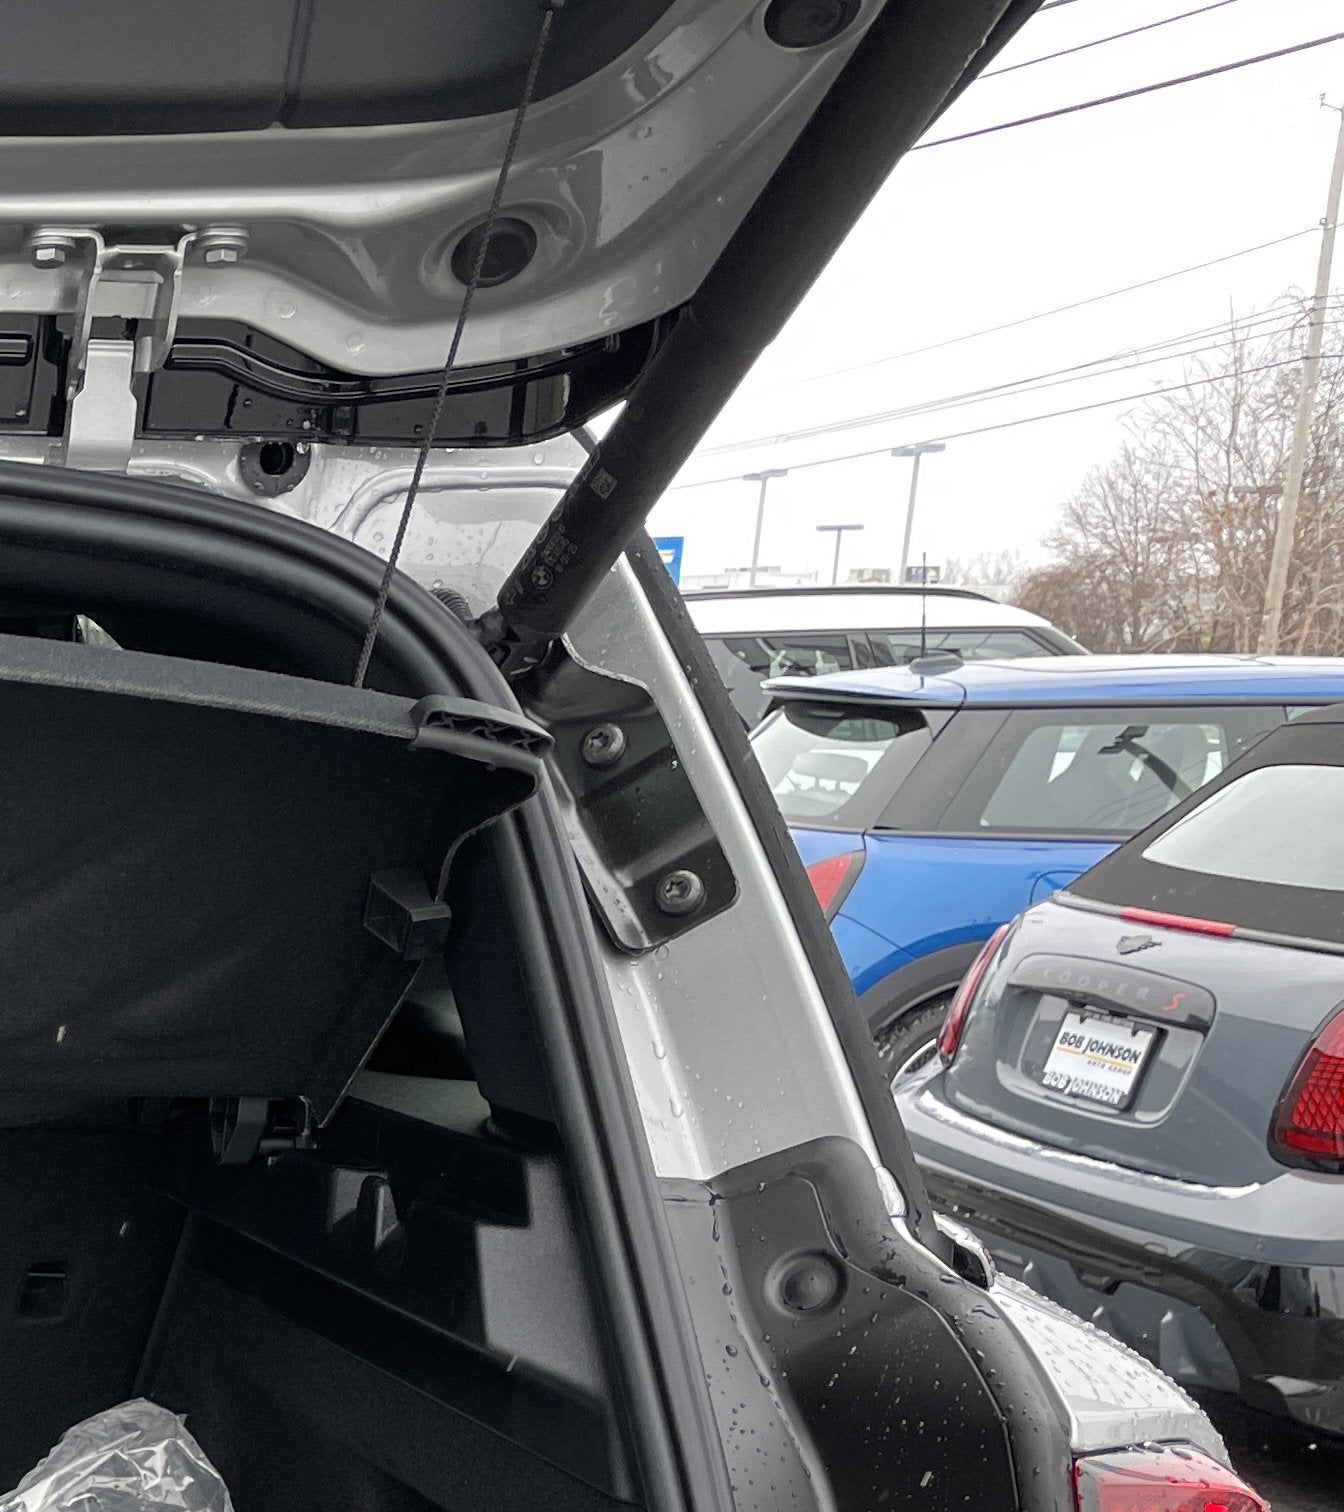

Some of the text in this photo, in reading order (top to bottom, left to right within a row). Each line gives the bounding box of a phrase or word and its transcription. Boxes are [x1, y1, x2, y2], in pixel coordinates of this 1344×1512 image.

[1044, 968, 1188, 1013] COOPER S
[1059, 1032, 1141, 1063] BOB JOHNSON
